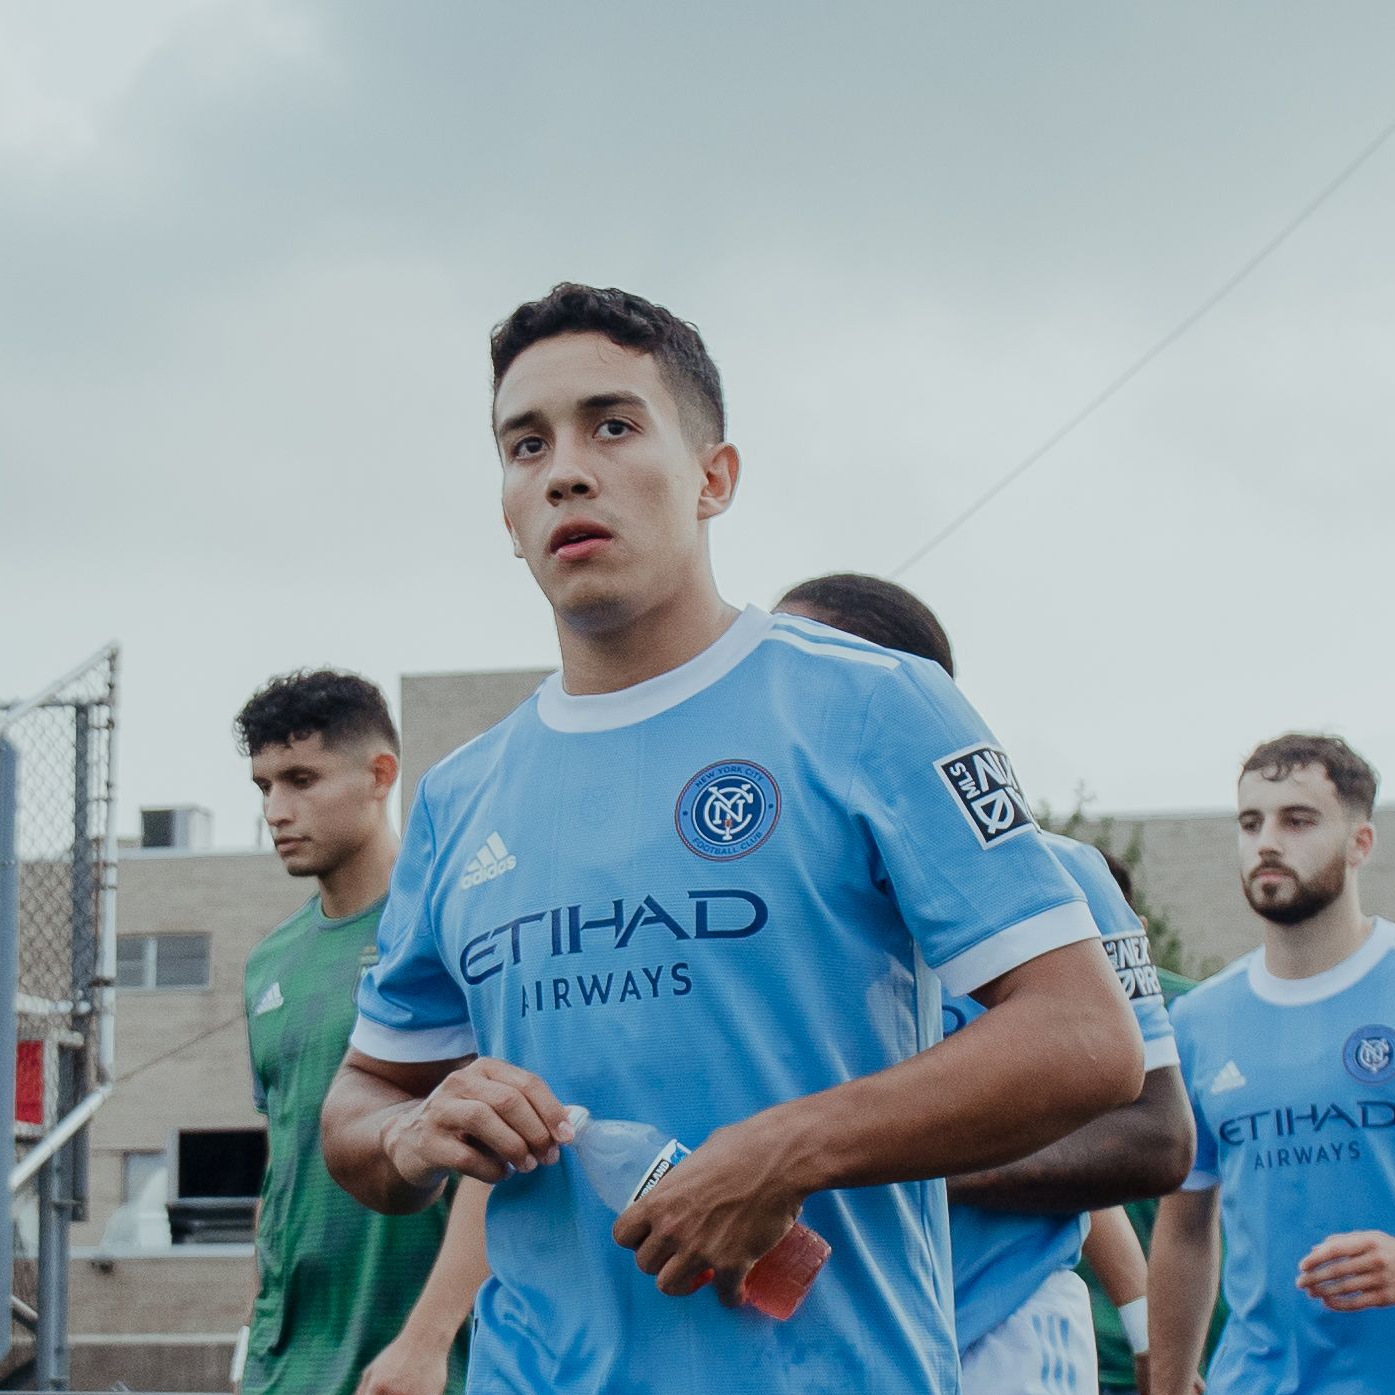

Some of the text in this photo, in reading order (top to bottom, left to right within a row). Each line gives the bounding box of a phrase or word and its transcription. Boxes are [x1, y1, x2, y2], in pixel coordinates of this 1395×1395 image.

[695, 765, 764, 788] NEW YORK CITY
[949, 761, 981, 800] MLS
[691, 837, 738, 856] FOOTBALL
[460, 854, 517, 890] adidas
[459, 889, 769, 986] ETIHAD
[520, 962, 693, 1019] AIRWAYS
[1254, 1140, 1362, 1171] AIRWAYS
